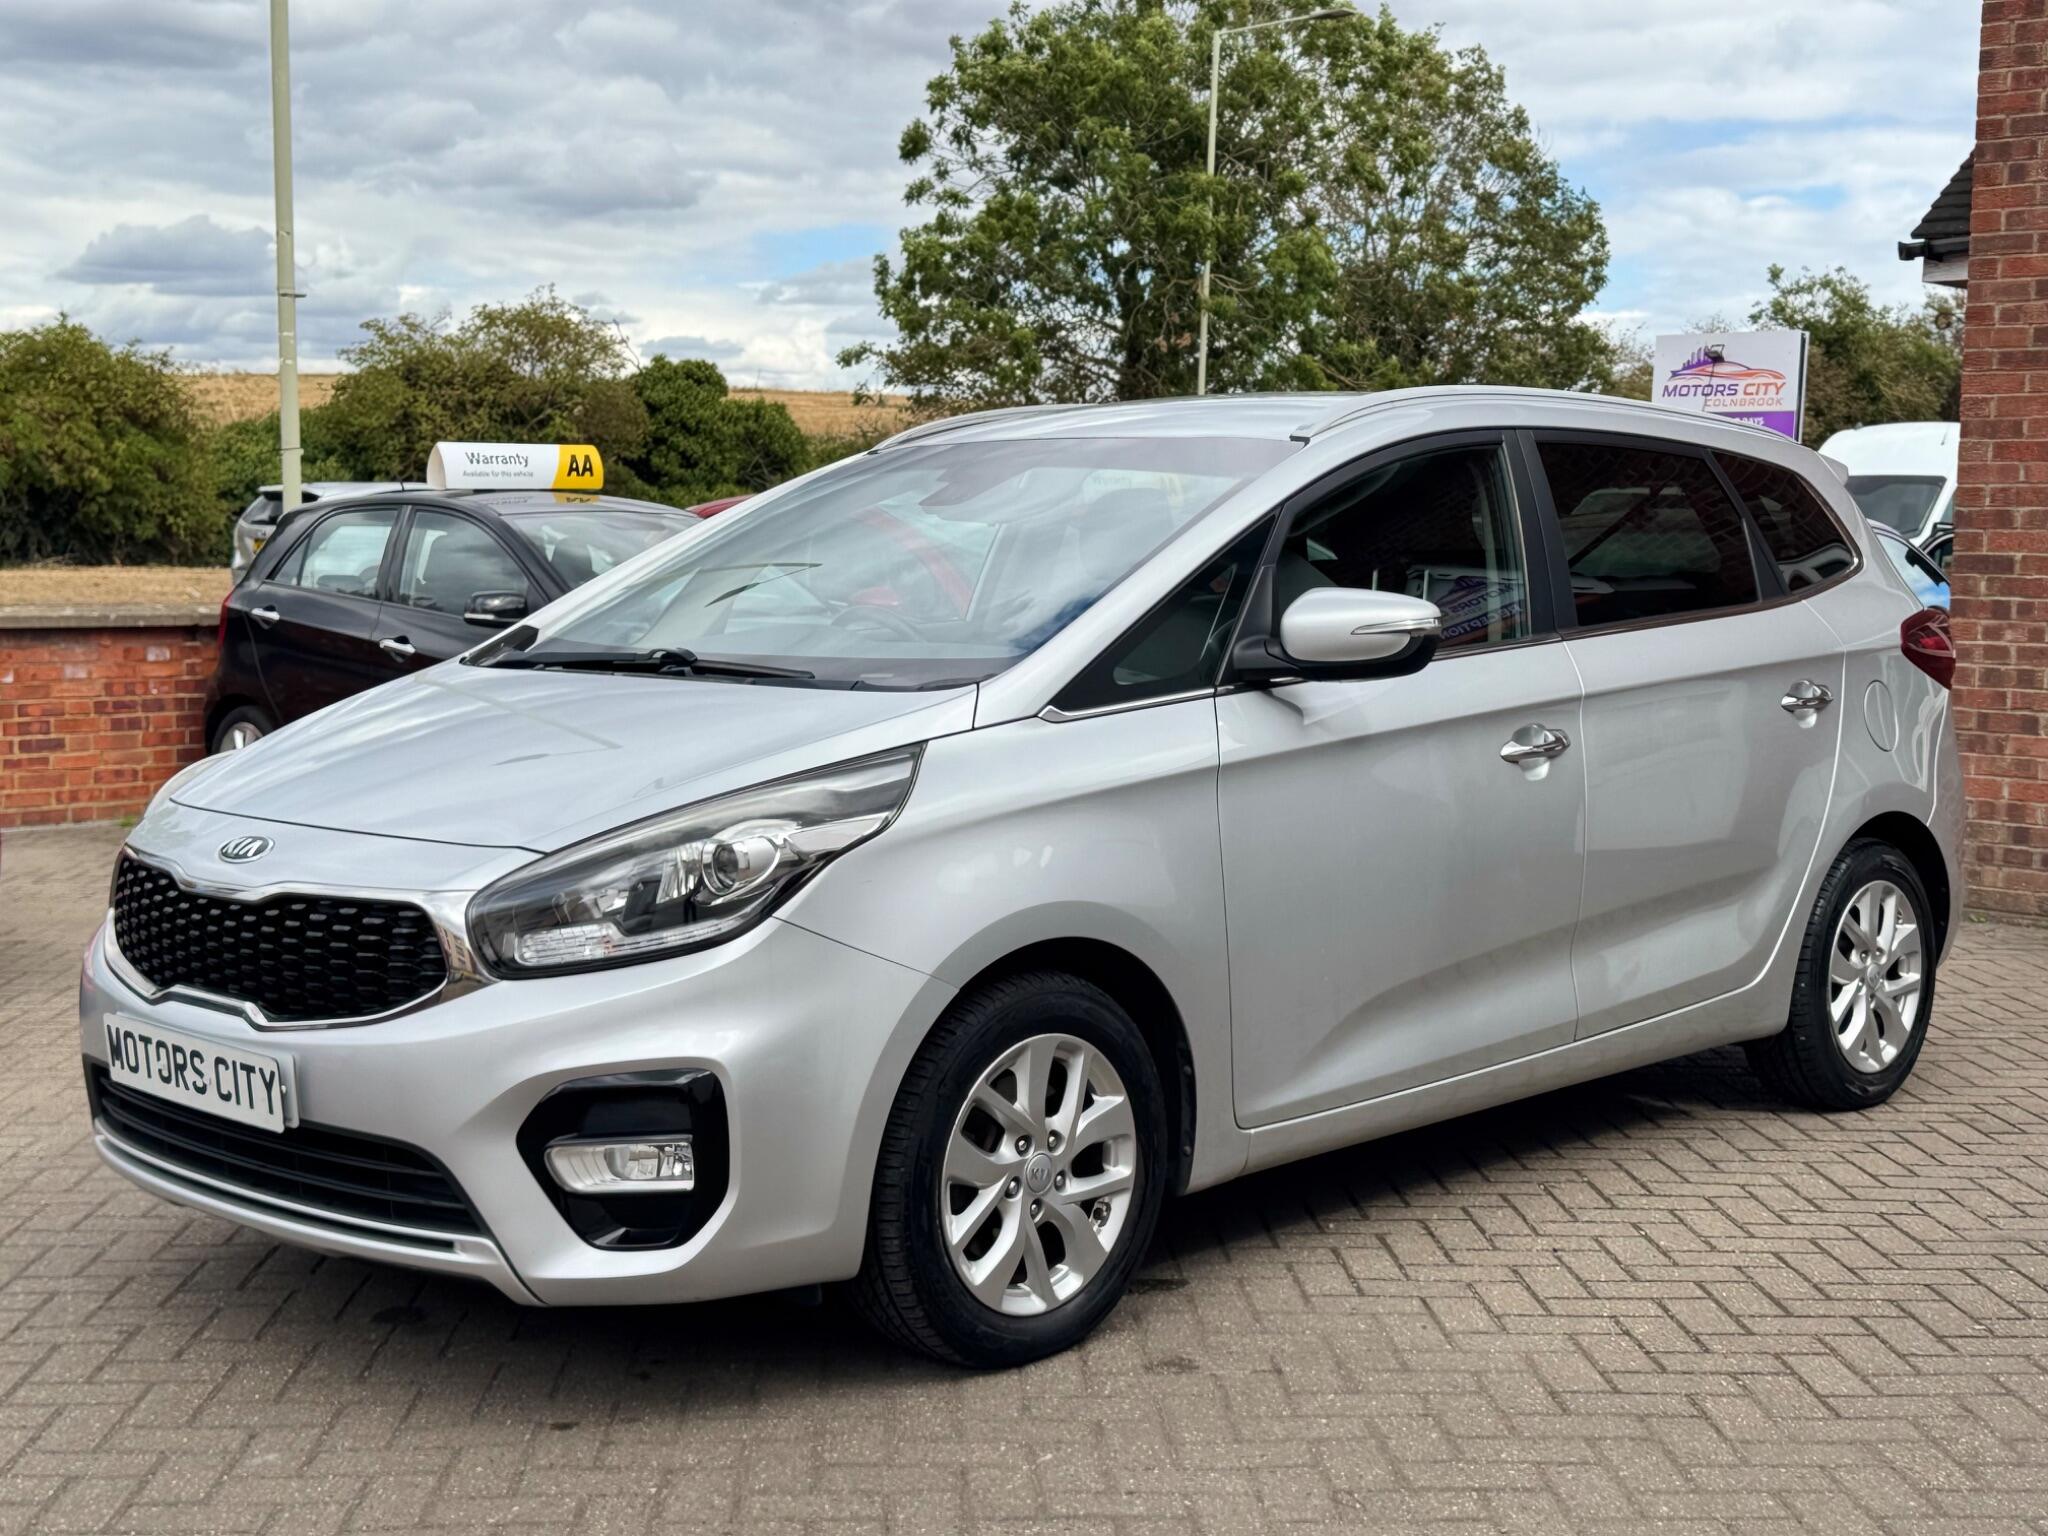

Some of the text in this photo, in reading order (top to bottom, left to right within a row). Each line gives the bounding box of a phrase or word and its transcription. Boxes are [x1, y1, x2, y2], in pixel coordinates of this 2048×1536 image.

[1662, 382, 1786, 398] MOTORS CITY
[1704, 397, 1783, 408] COLNBROOK
[464, 452, 529, 468] Warranty
[566, 454, 594, 477] AA
[222, 837, 264, 857] KIA
[107, 1024, 276, 1115] MOTORS CITY
